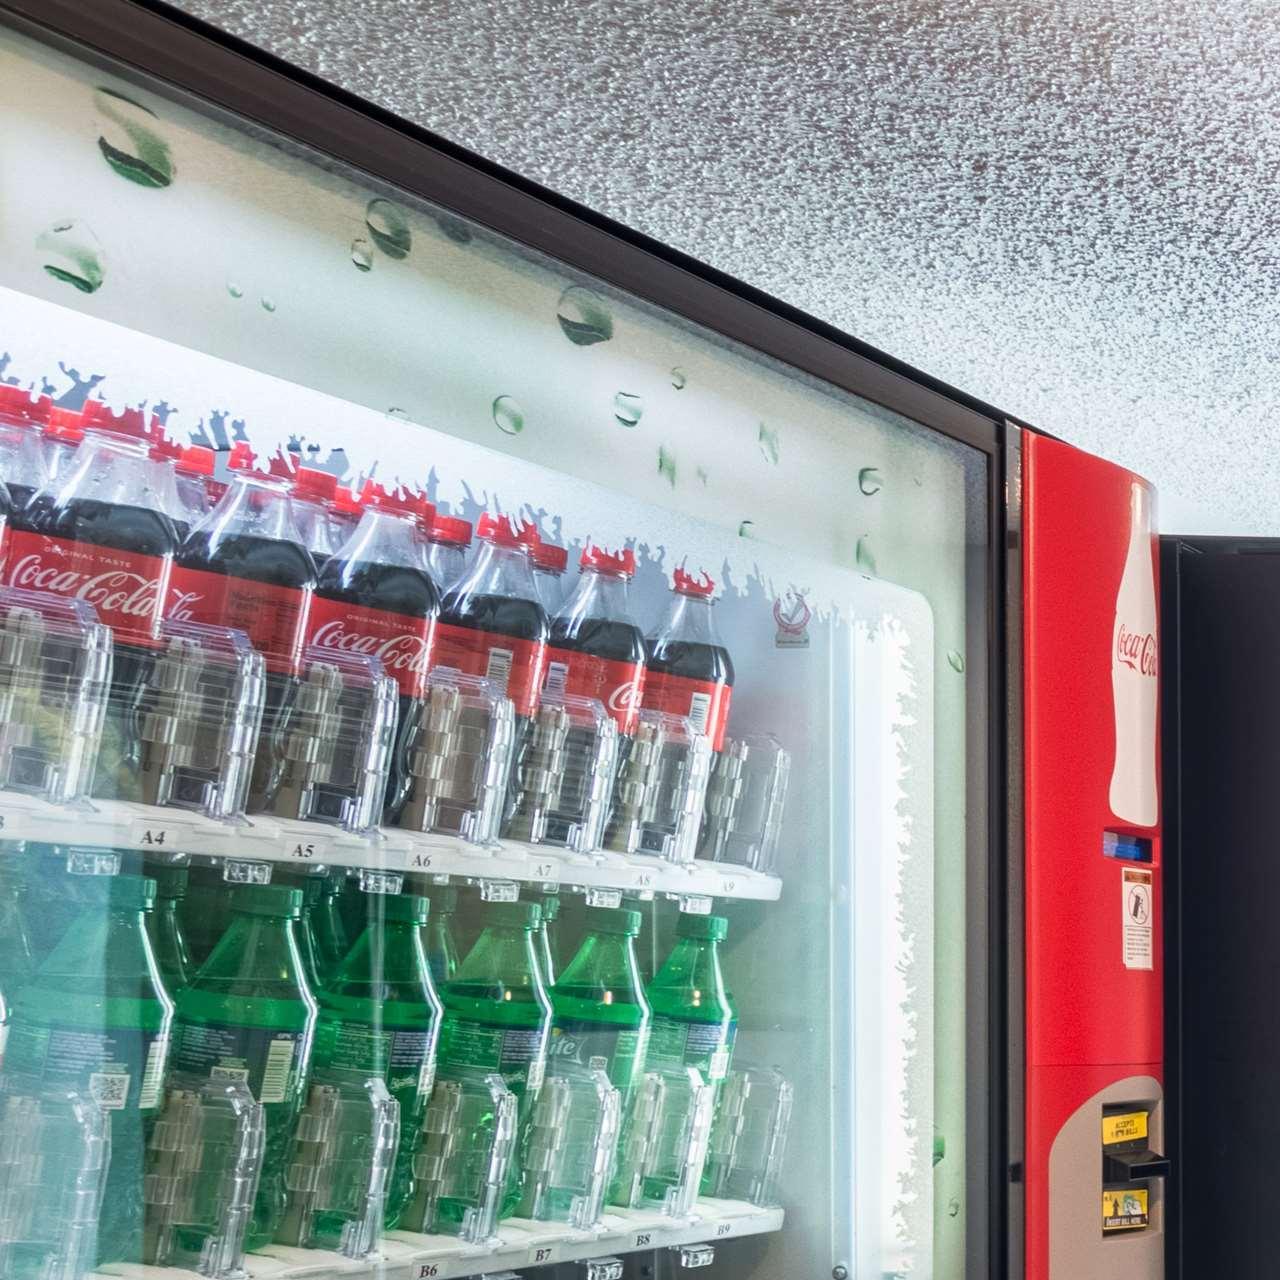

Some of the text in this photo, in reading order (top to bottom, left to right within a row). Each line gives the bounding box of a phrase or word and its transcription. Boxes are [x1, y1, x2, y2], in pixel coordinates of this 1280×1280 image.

[100, 556, 132, 569] TASTE
[140, 829, 167, 846] A4
[291, 844, 314, 859] A5
[411, 854, 432, 868] A6
[534, 863, 552, 877] A7
[635, 1231, 651, 1247] B8
[534, 1247, 552, 1262] B7
[418, 1263, 438, 1279] B6
